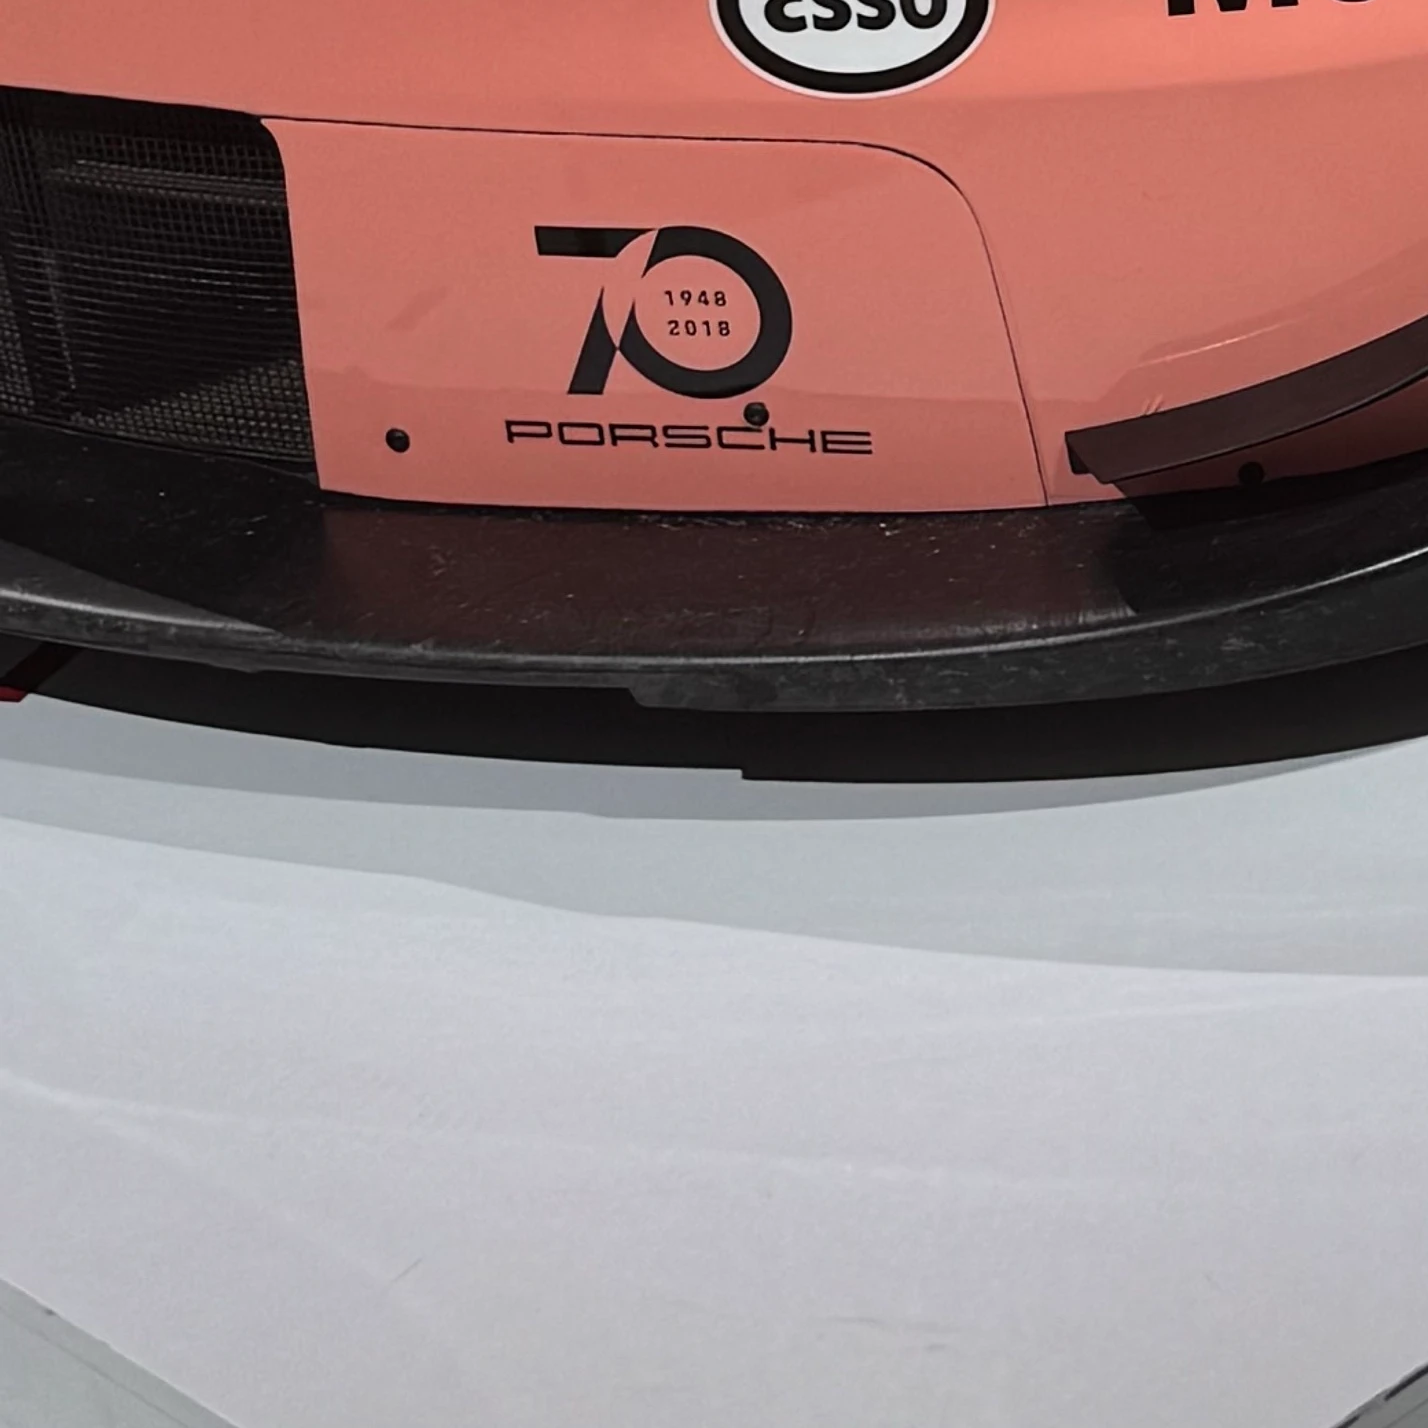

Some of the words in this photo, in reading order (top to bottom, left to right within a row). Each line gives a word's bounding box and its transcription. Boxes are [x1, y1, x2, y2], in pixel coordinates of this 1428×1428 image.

[664, 289, 727, 308] 1948
[667, 319, 731, 338] 2018
[504, 419, 874, 456] PORSCHE
